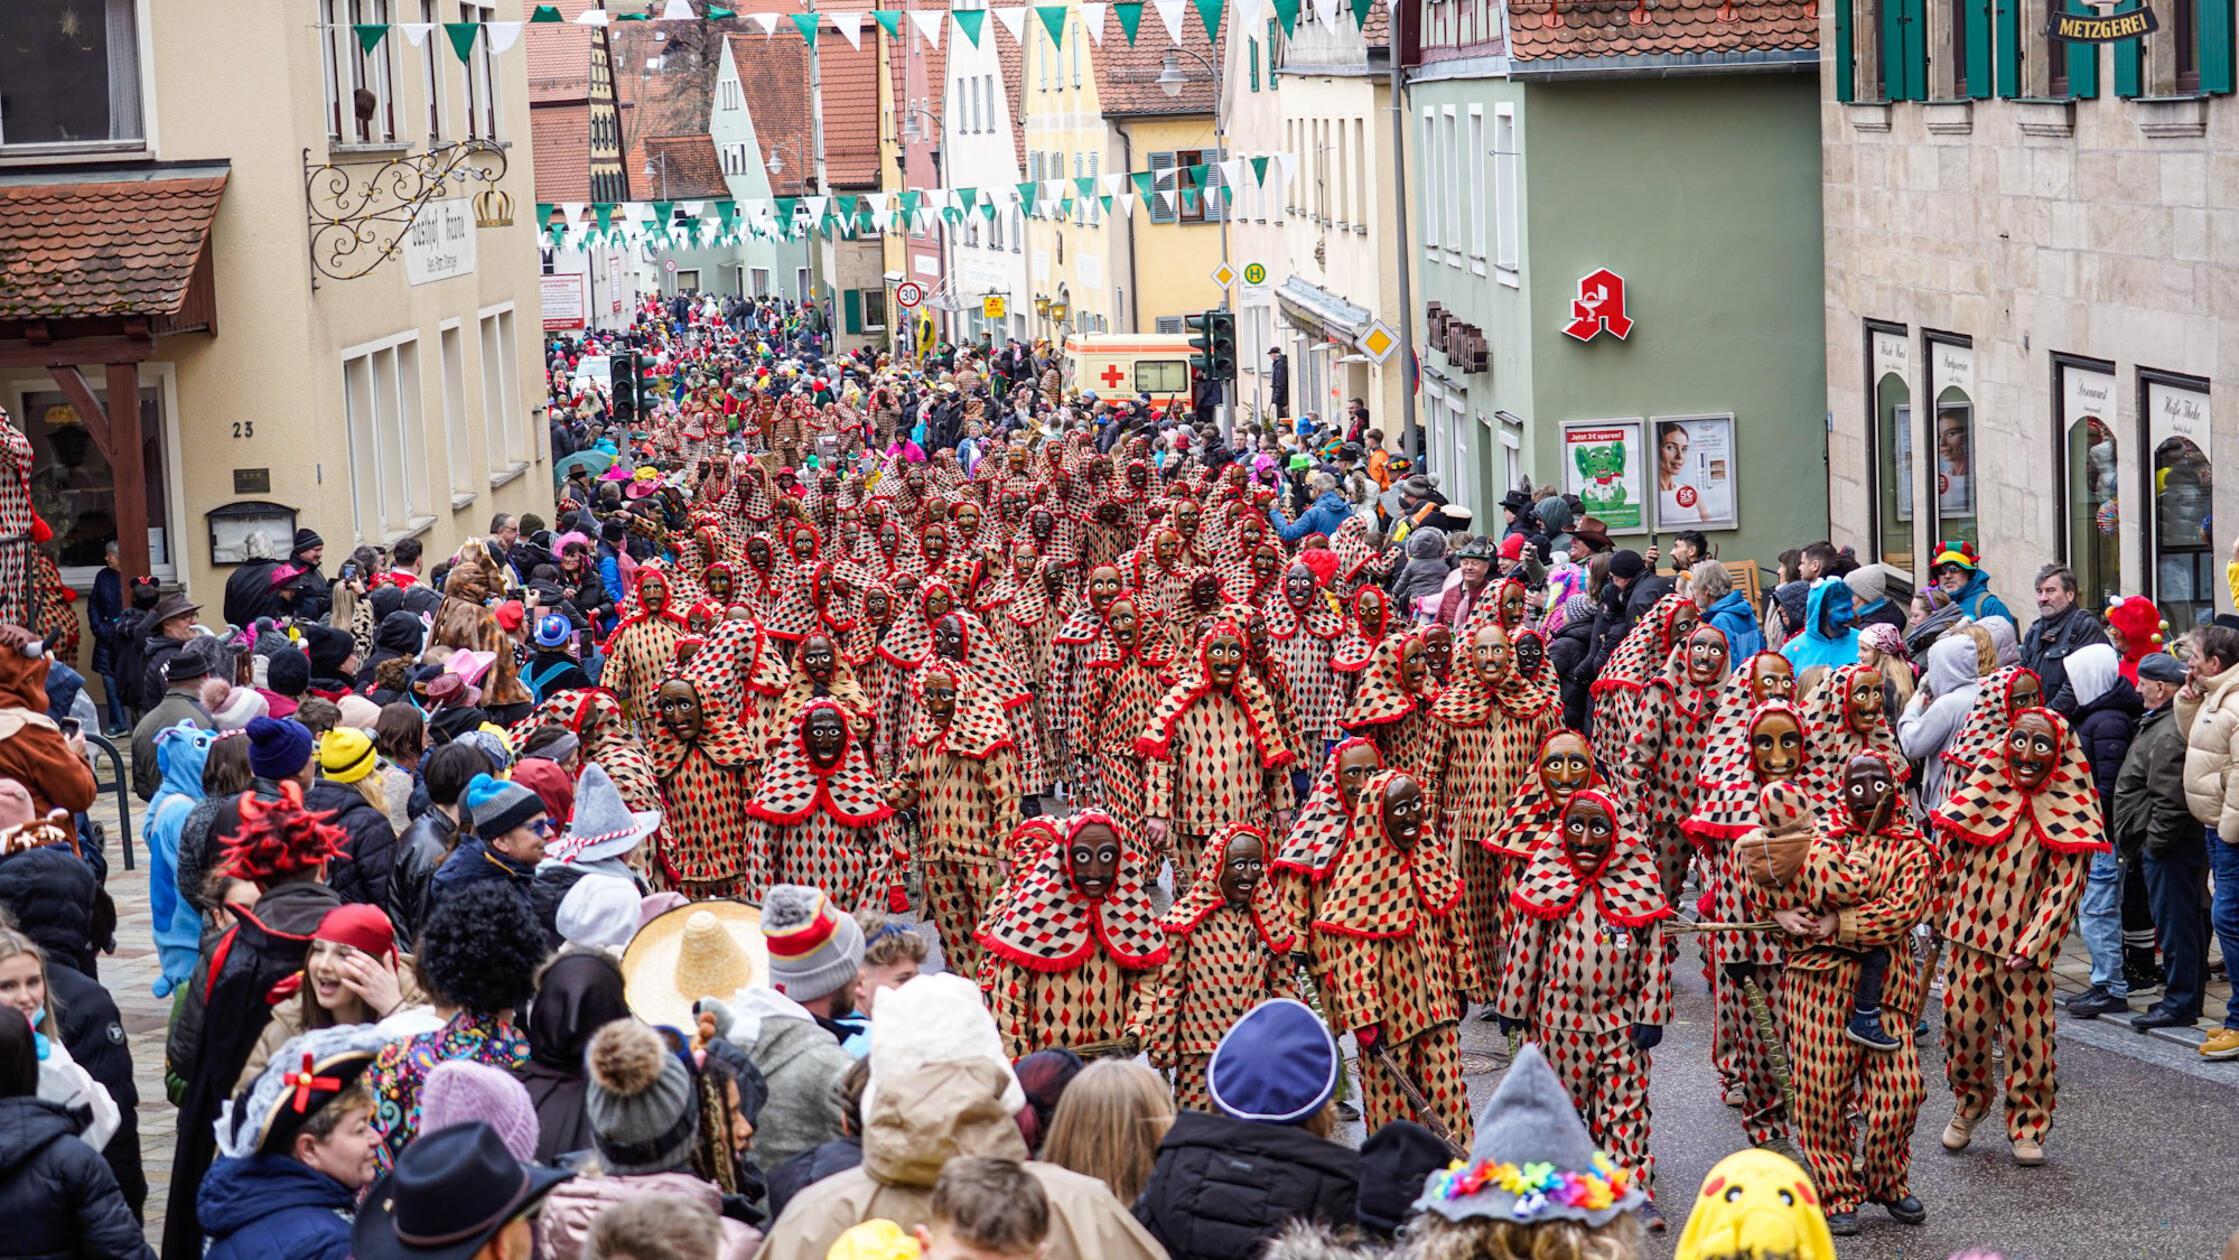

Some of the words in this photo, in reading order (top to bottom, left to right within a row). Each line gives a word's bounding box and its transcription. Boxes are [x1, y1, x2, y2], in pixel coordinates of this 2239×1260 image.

[2058, 13, 2148, 38] METZGEREI
[901, 289, 917, 301] 30
[233, 421, 254, 438] 23
[1570, 433, 1587, 441] Jetzt
